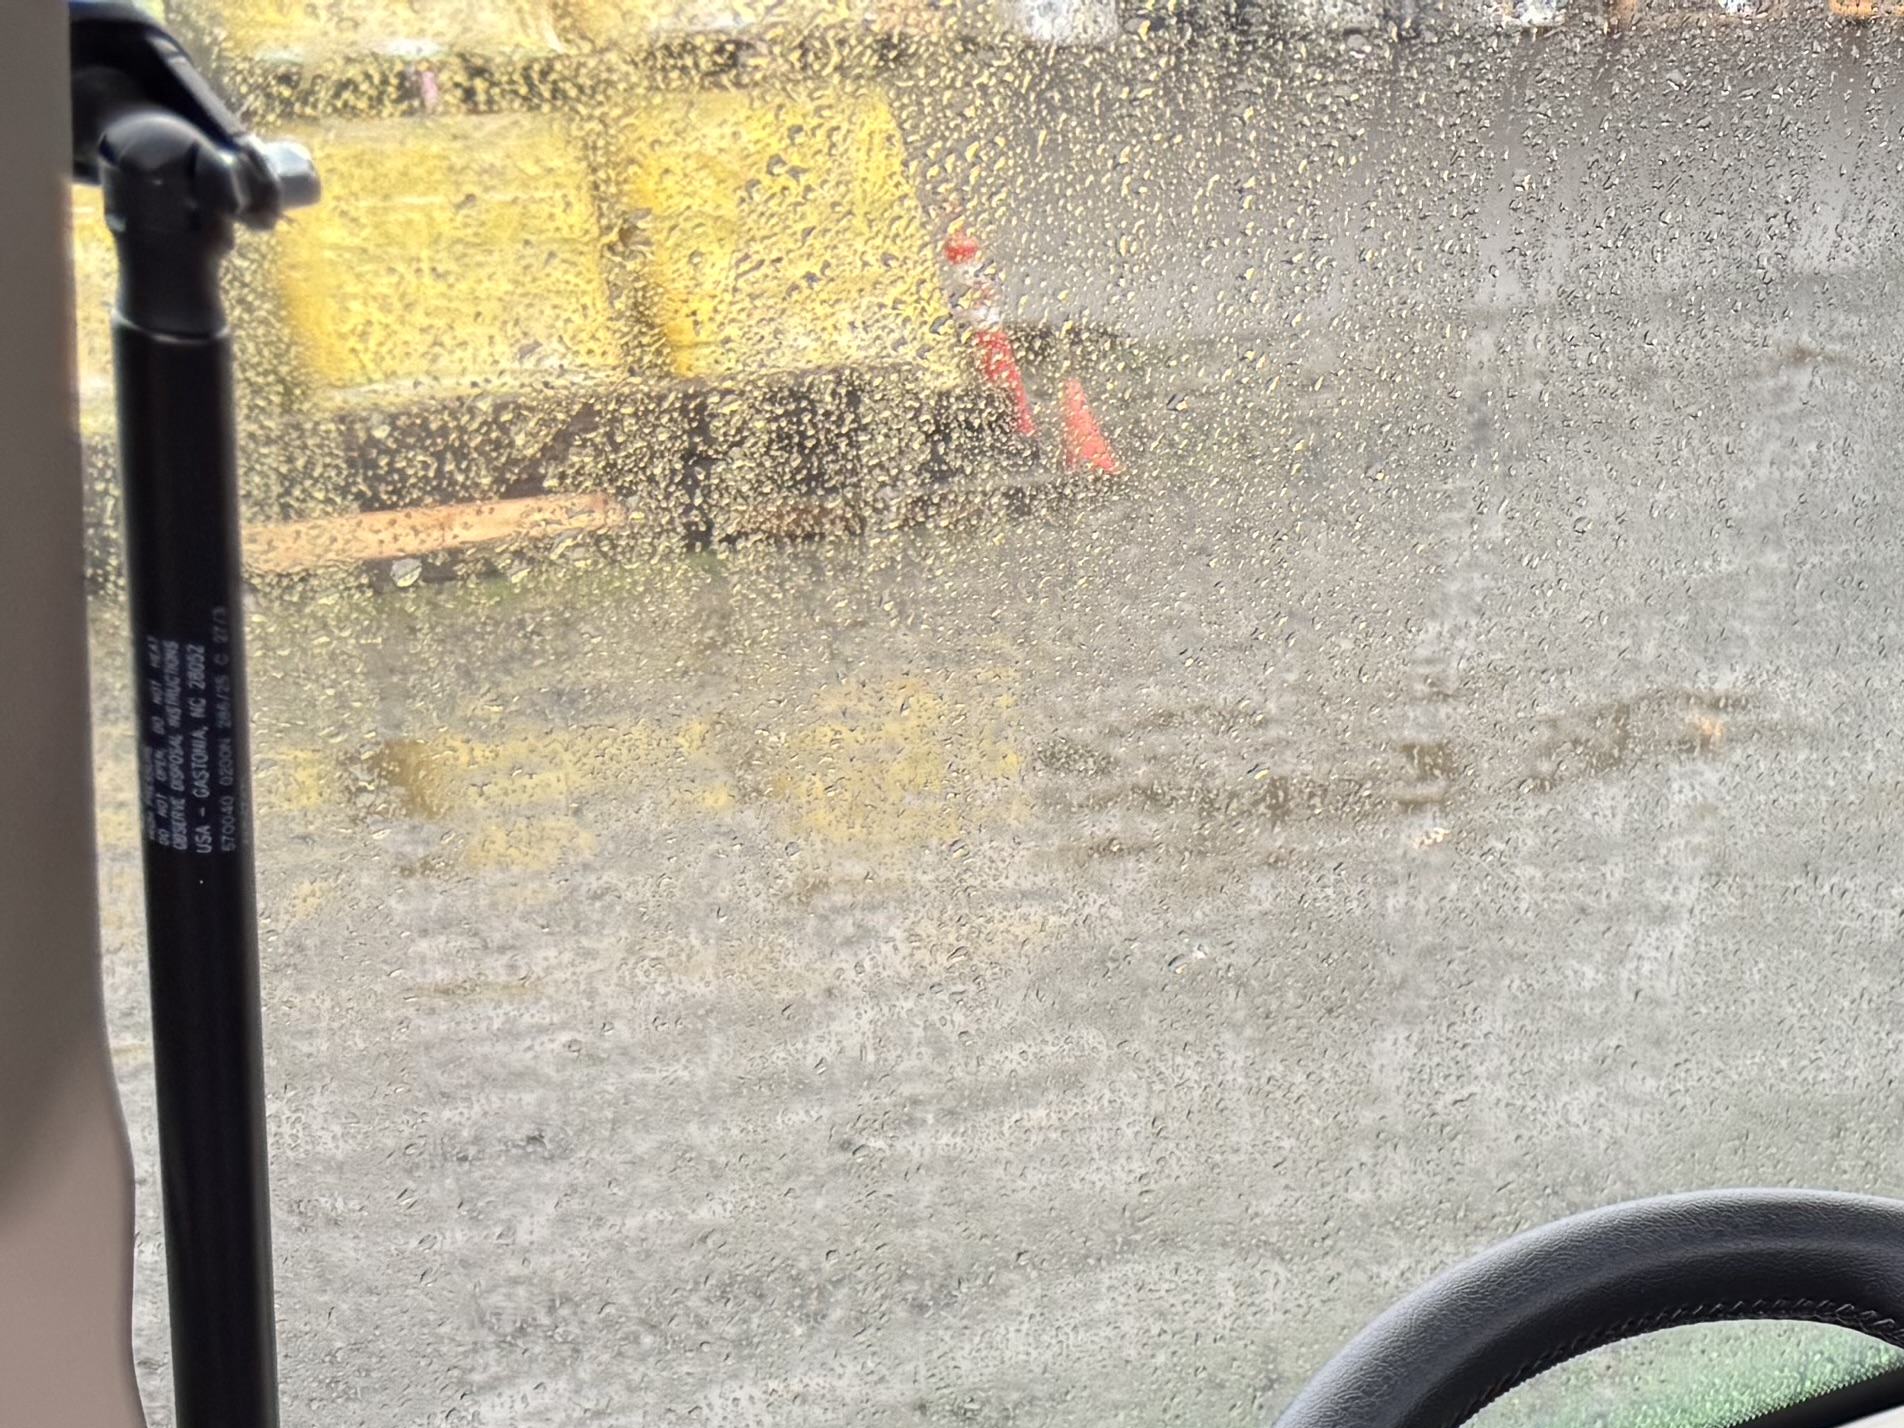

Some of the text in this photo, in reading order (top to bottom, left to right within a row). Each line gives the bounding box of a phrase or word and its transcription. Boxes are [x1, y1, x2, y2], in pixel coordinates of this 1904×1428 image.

[187, 644, 205, 689] 28052
[190, 698, 207, 718] NC
[191, 726, 211, 798] GASTONIA,
[194, 825, 212, 853] USA
